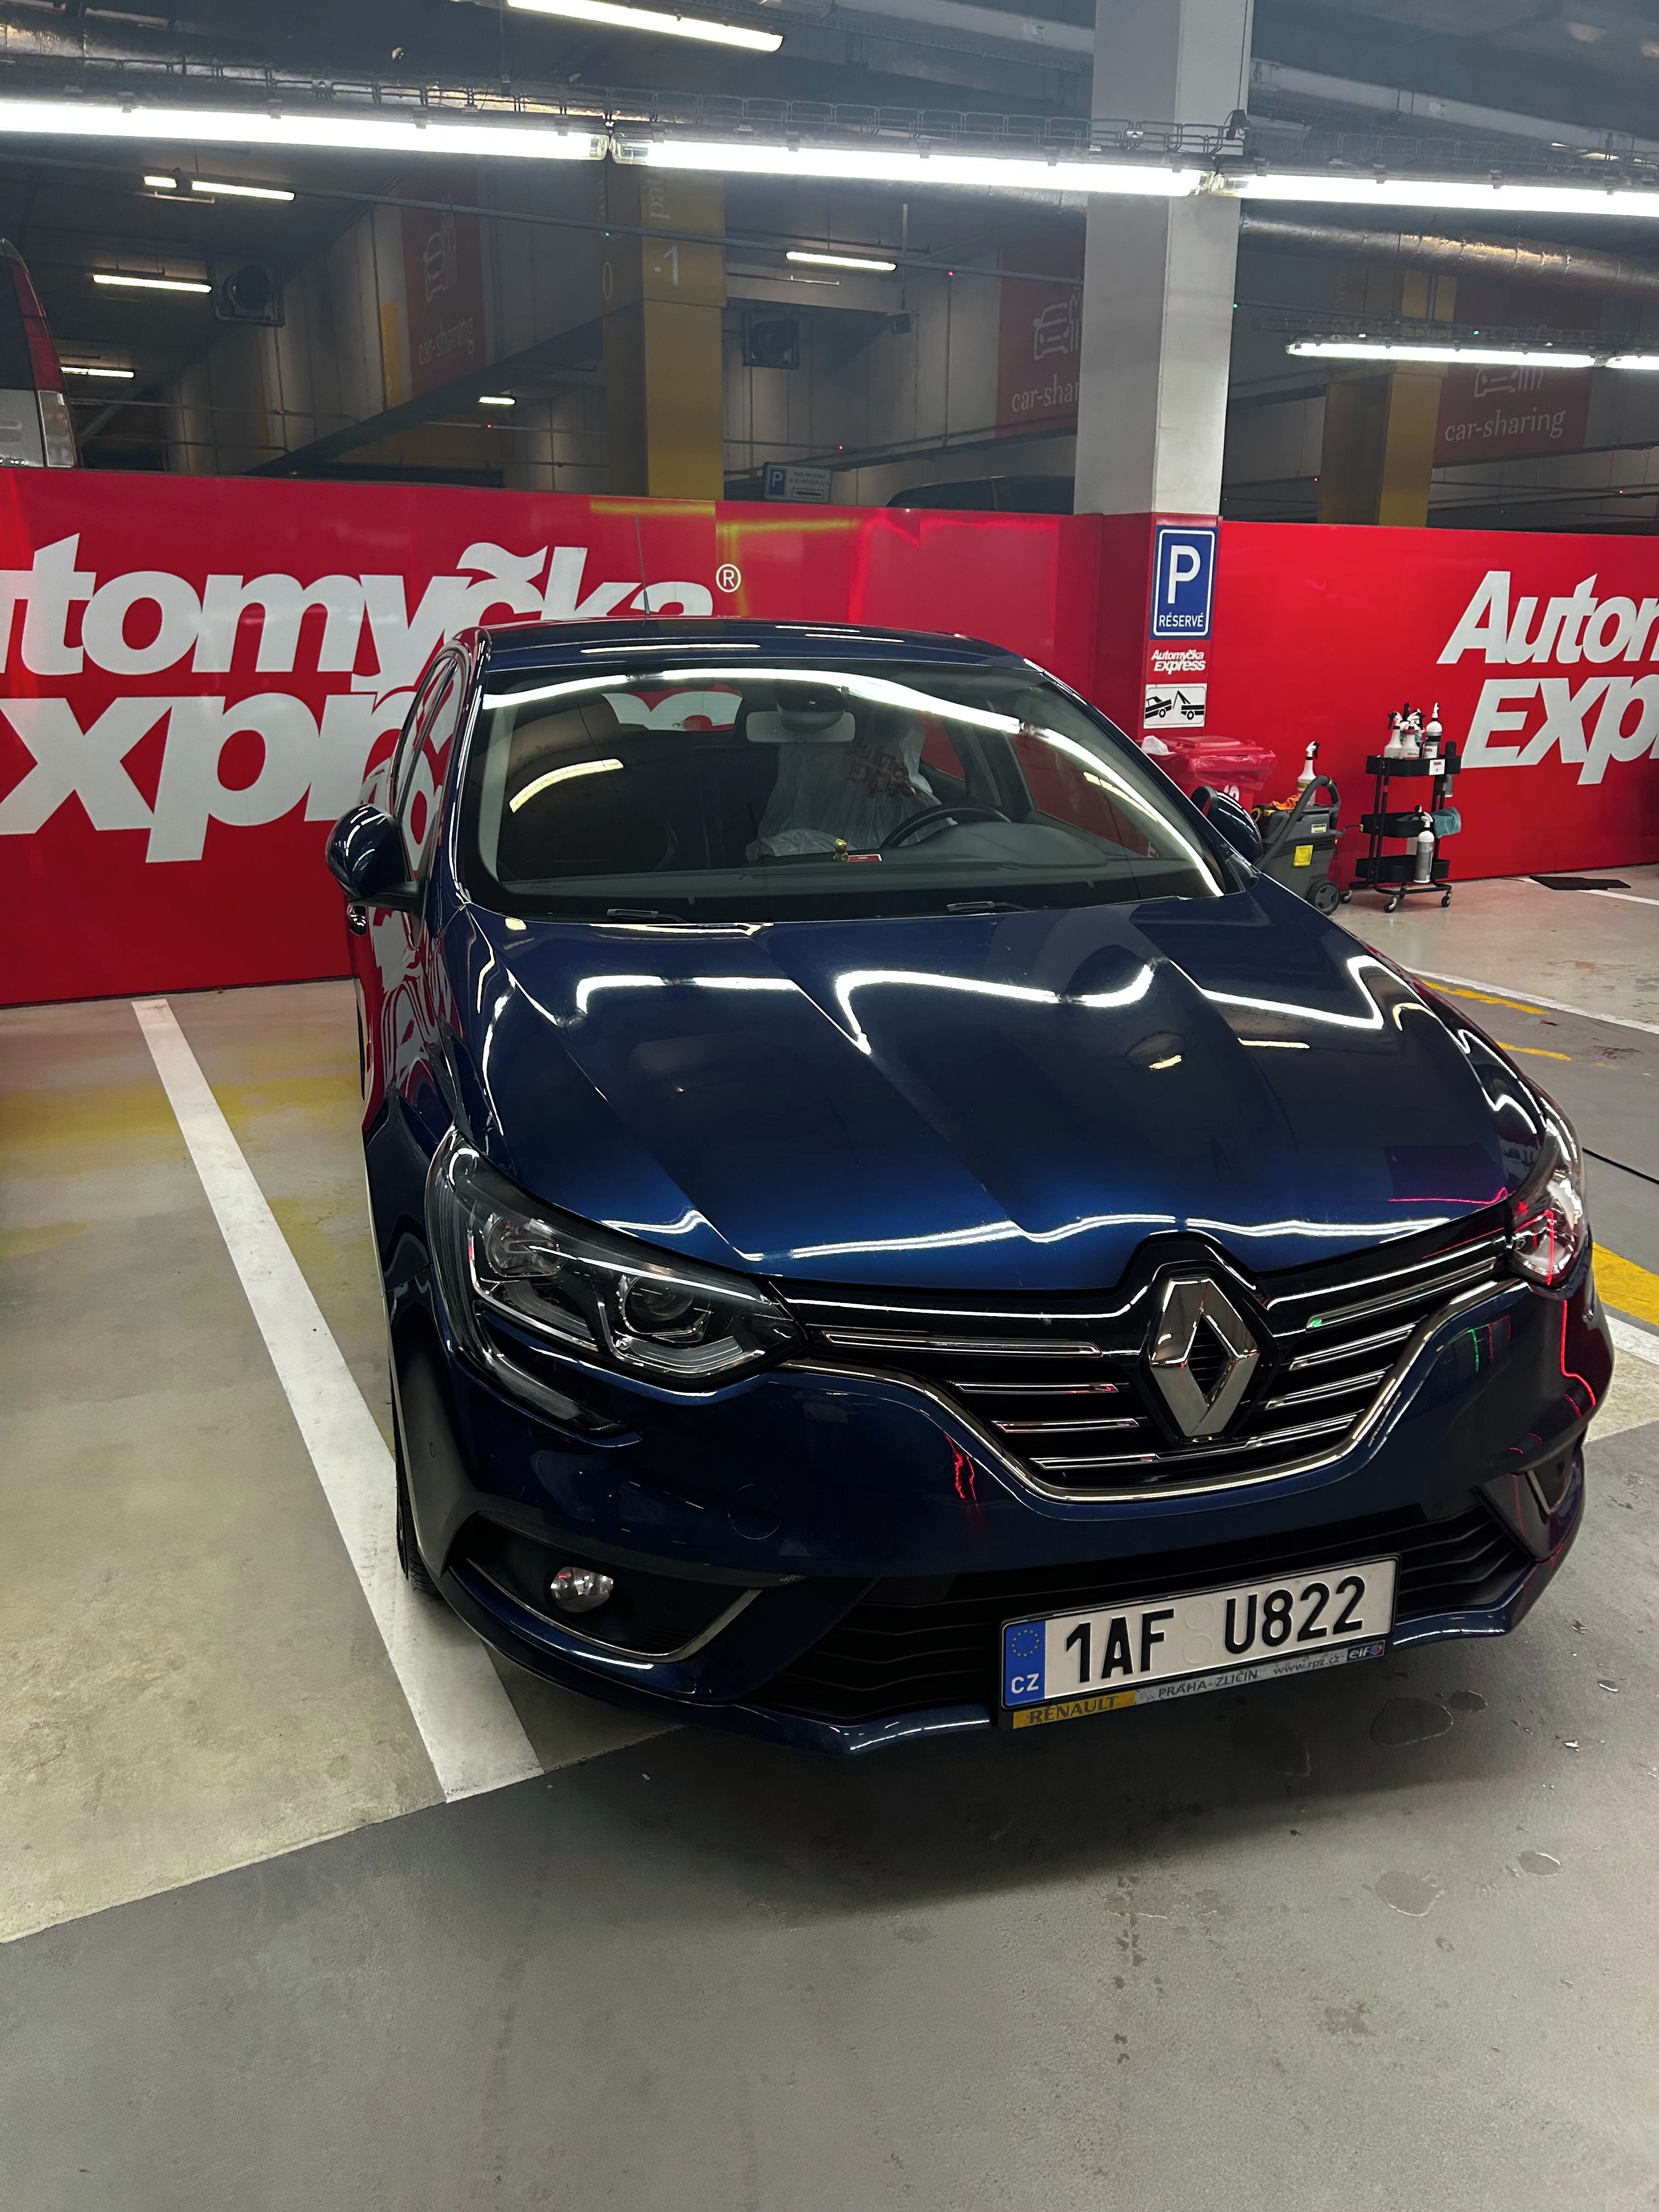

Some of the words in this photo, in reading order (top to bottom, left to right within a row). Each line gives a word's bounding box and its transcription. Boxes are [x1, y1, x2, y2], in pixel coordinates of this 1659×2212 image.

[1012, 374, 1080, 411] car-shar
[1445, 408, 1566, 441] car-sharing
[772, 471, 783, 487] P
[1167, 545, 1201, 604] P
[1159, 612, 1204, 627] RÉSERVÉ
[1151, 649, 1205, 661] Automyčka
[1065, 1607, 1175, 1684] 1AF
[1223, 1575, 1366, 1655] U822
[1348, 1646, 1370, 1660] elf
[1011, 1673, 1039, 1694] CZ
[1026, 1695, 1119, 1725] RENAULT
